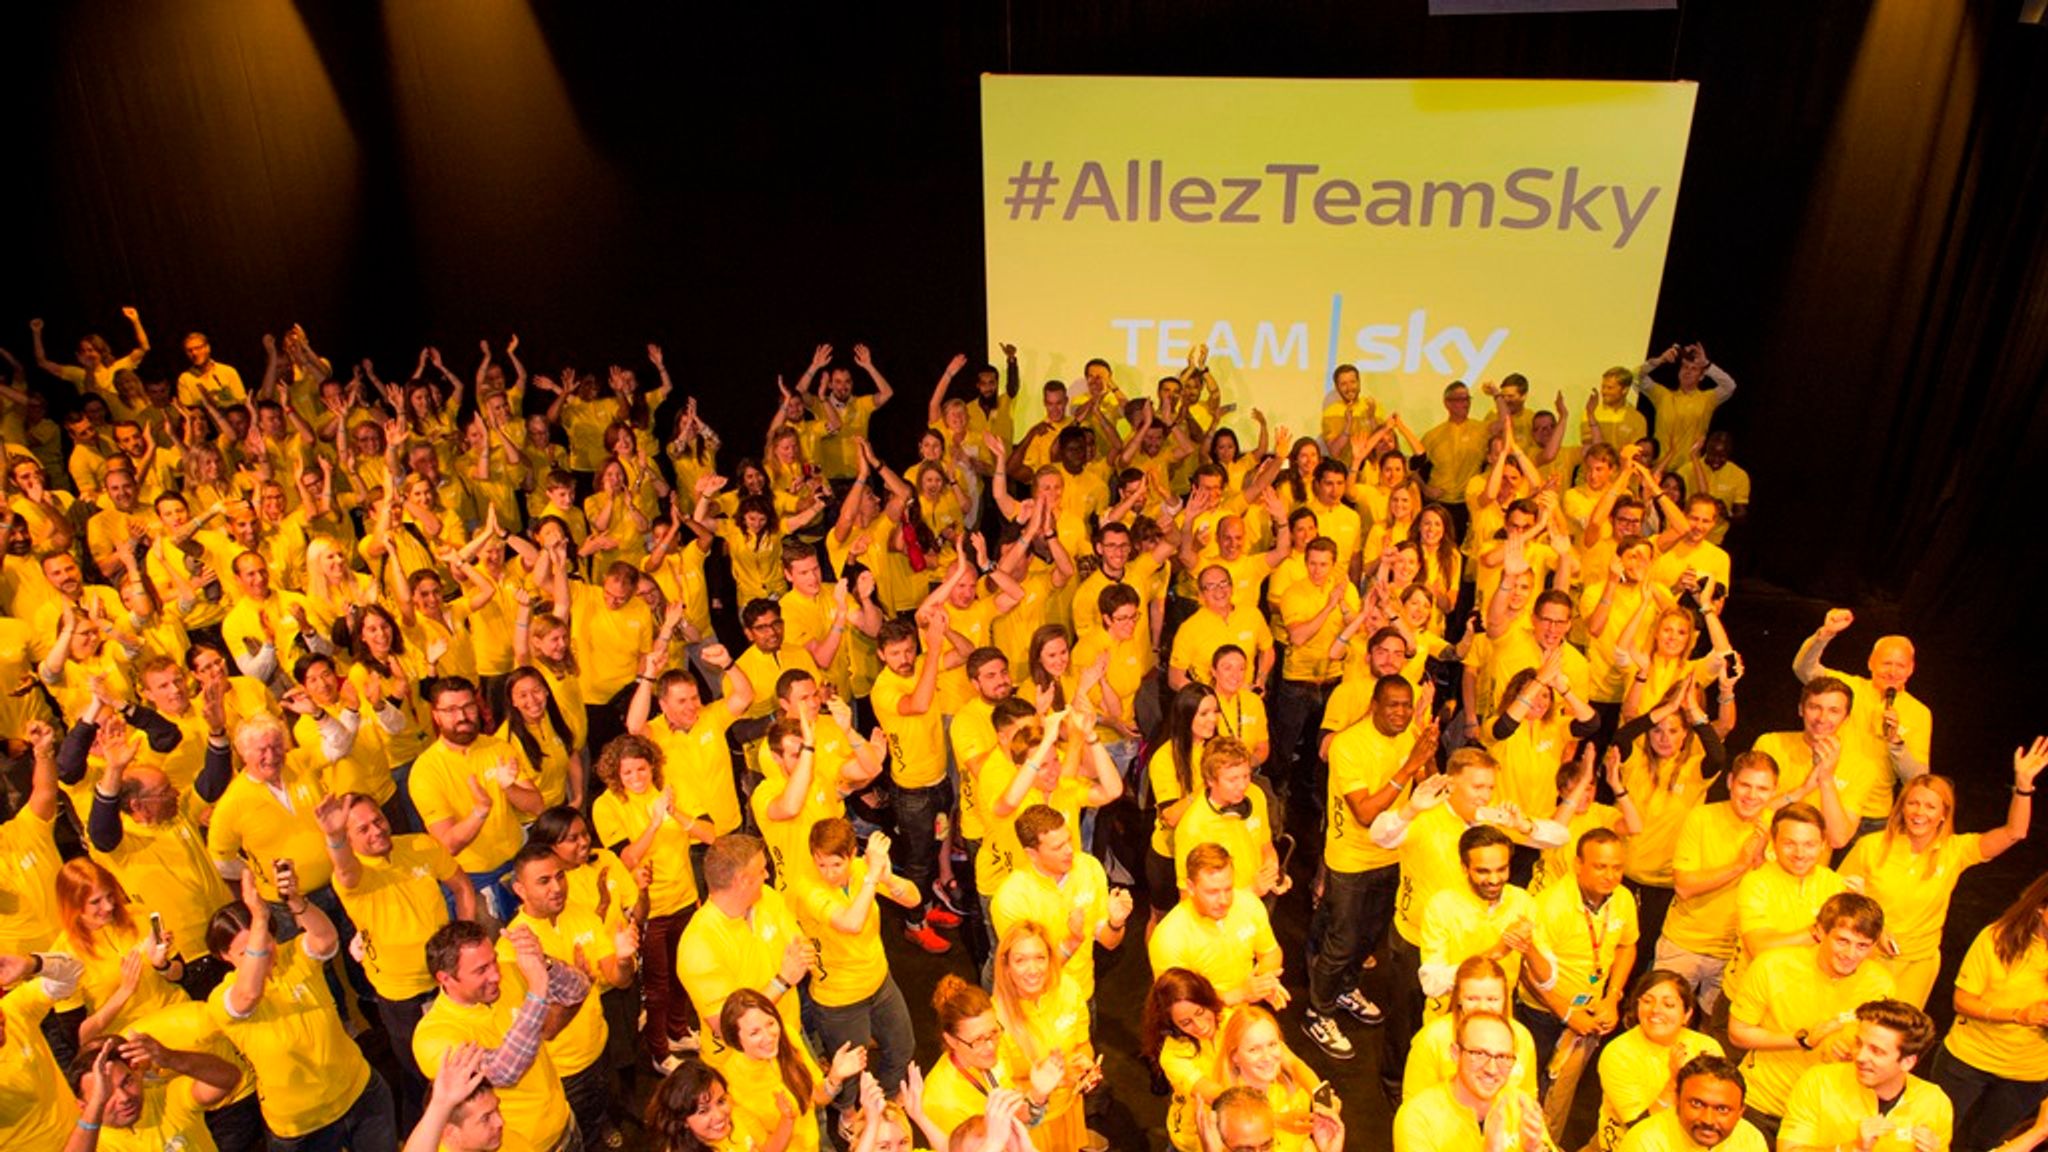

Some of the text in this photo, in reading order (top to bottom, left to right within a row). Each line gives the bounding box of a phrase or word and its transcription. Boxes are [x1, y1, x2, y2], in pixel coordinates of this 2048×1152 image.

[1004, 159, 1662, 249] #AllezTeamSky
[1111, 308, 1509, 386] TEAM sky
